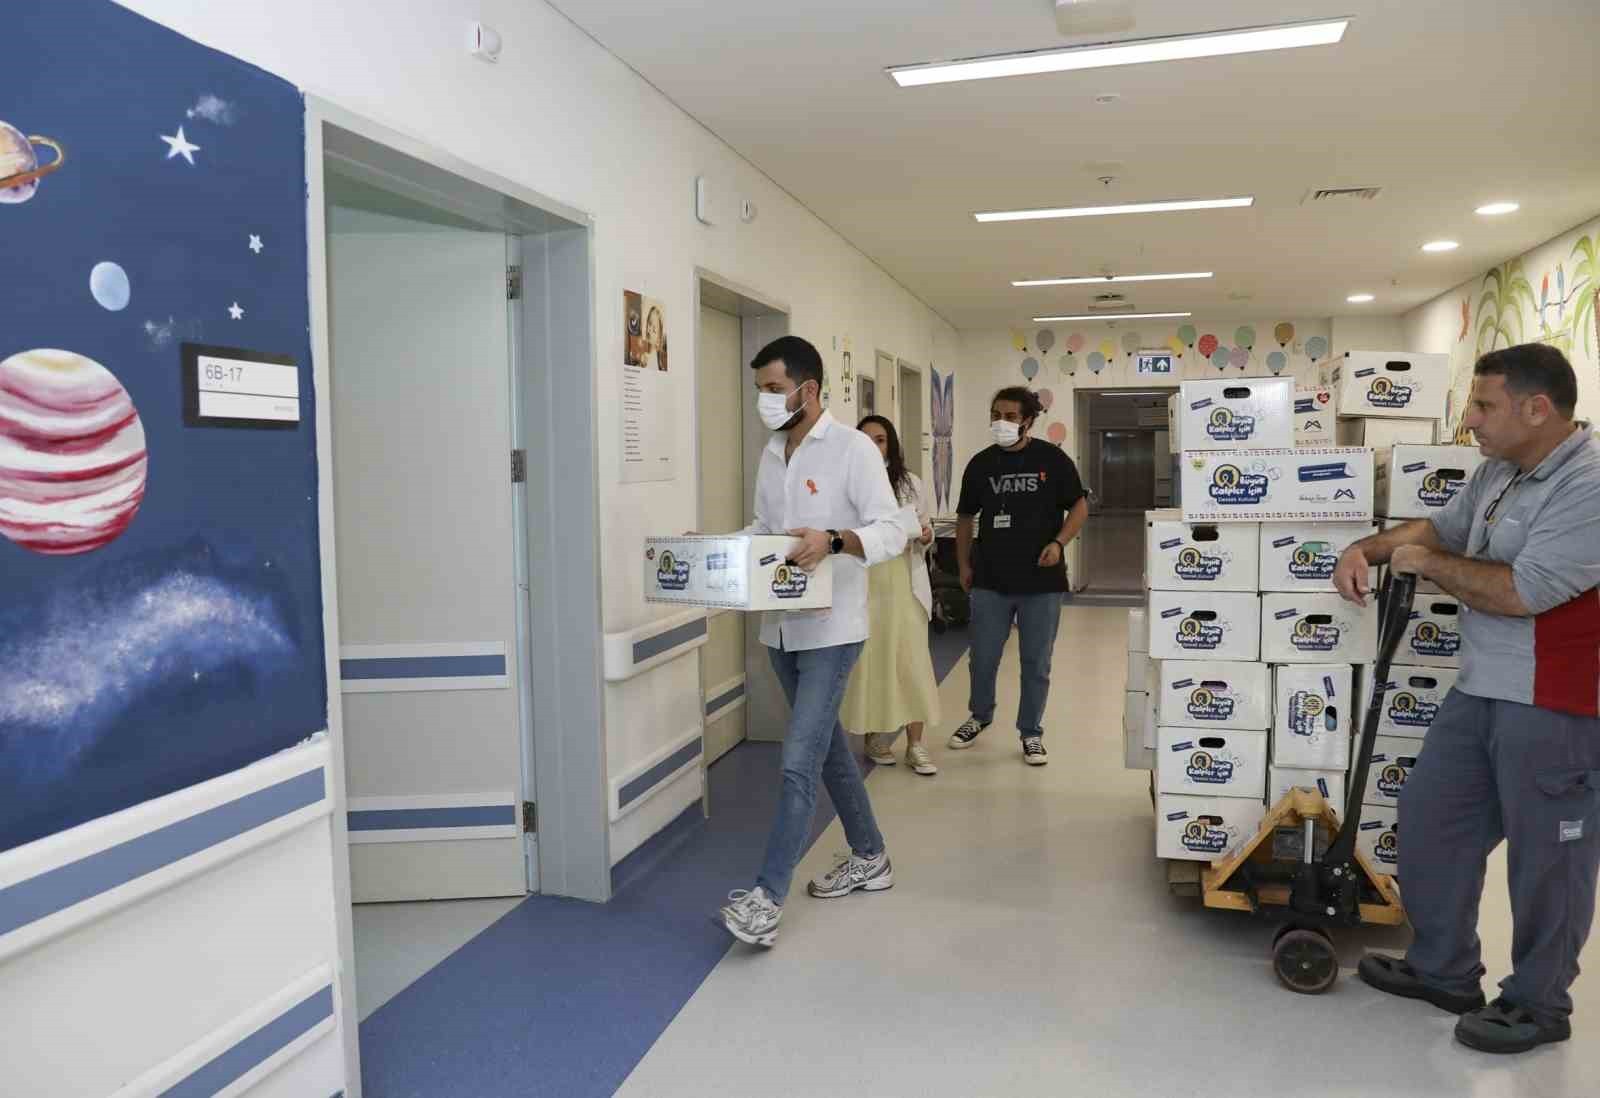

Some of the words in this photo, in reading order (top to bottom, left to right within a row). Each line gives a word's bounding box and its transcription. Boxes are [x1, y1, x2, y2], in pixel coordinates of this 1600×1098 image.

[206, 364, 243, 382] 6B-17
[989, 473, 1039, 494] VANS
[1212, 484, 1244, 497] Kalpler
